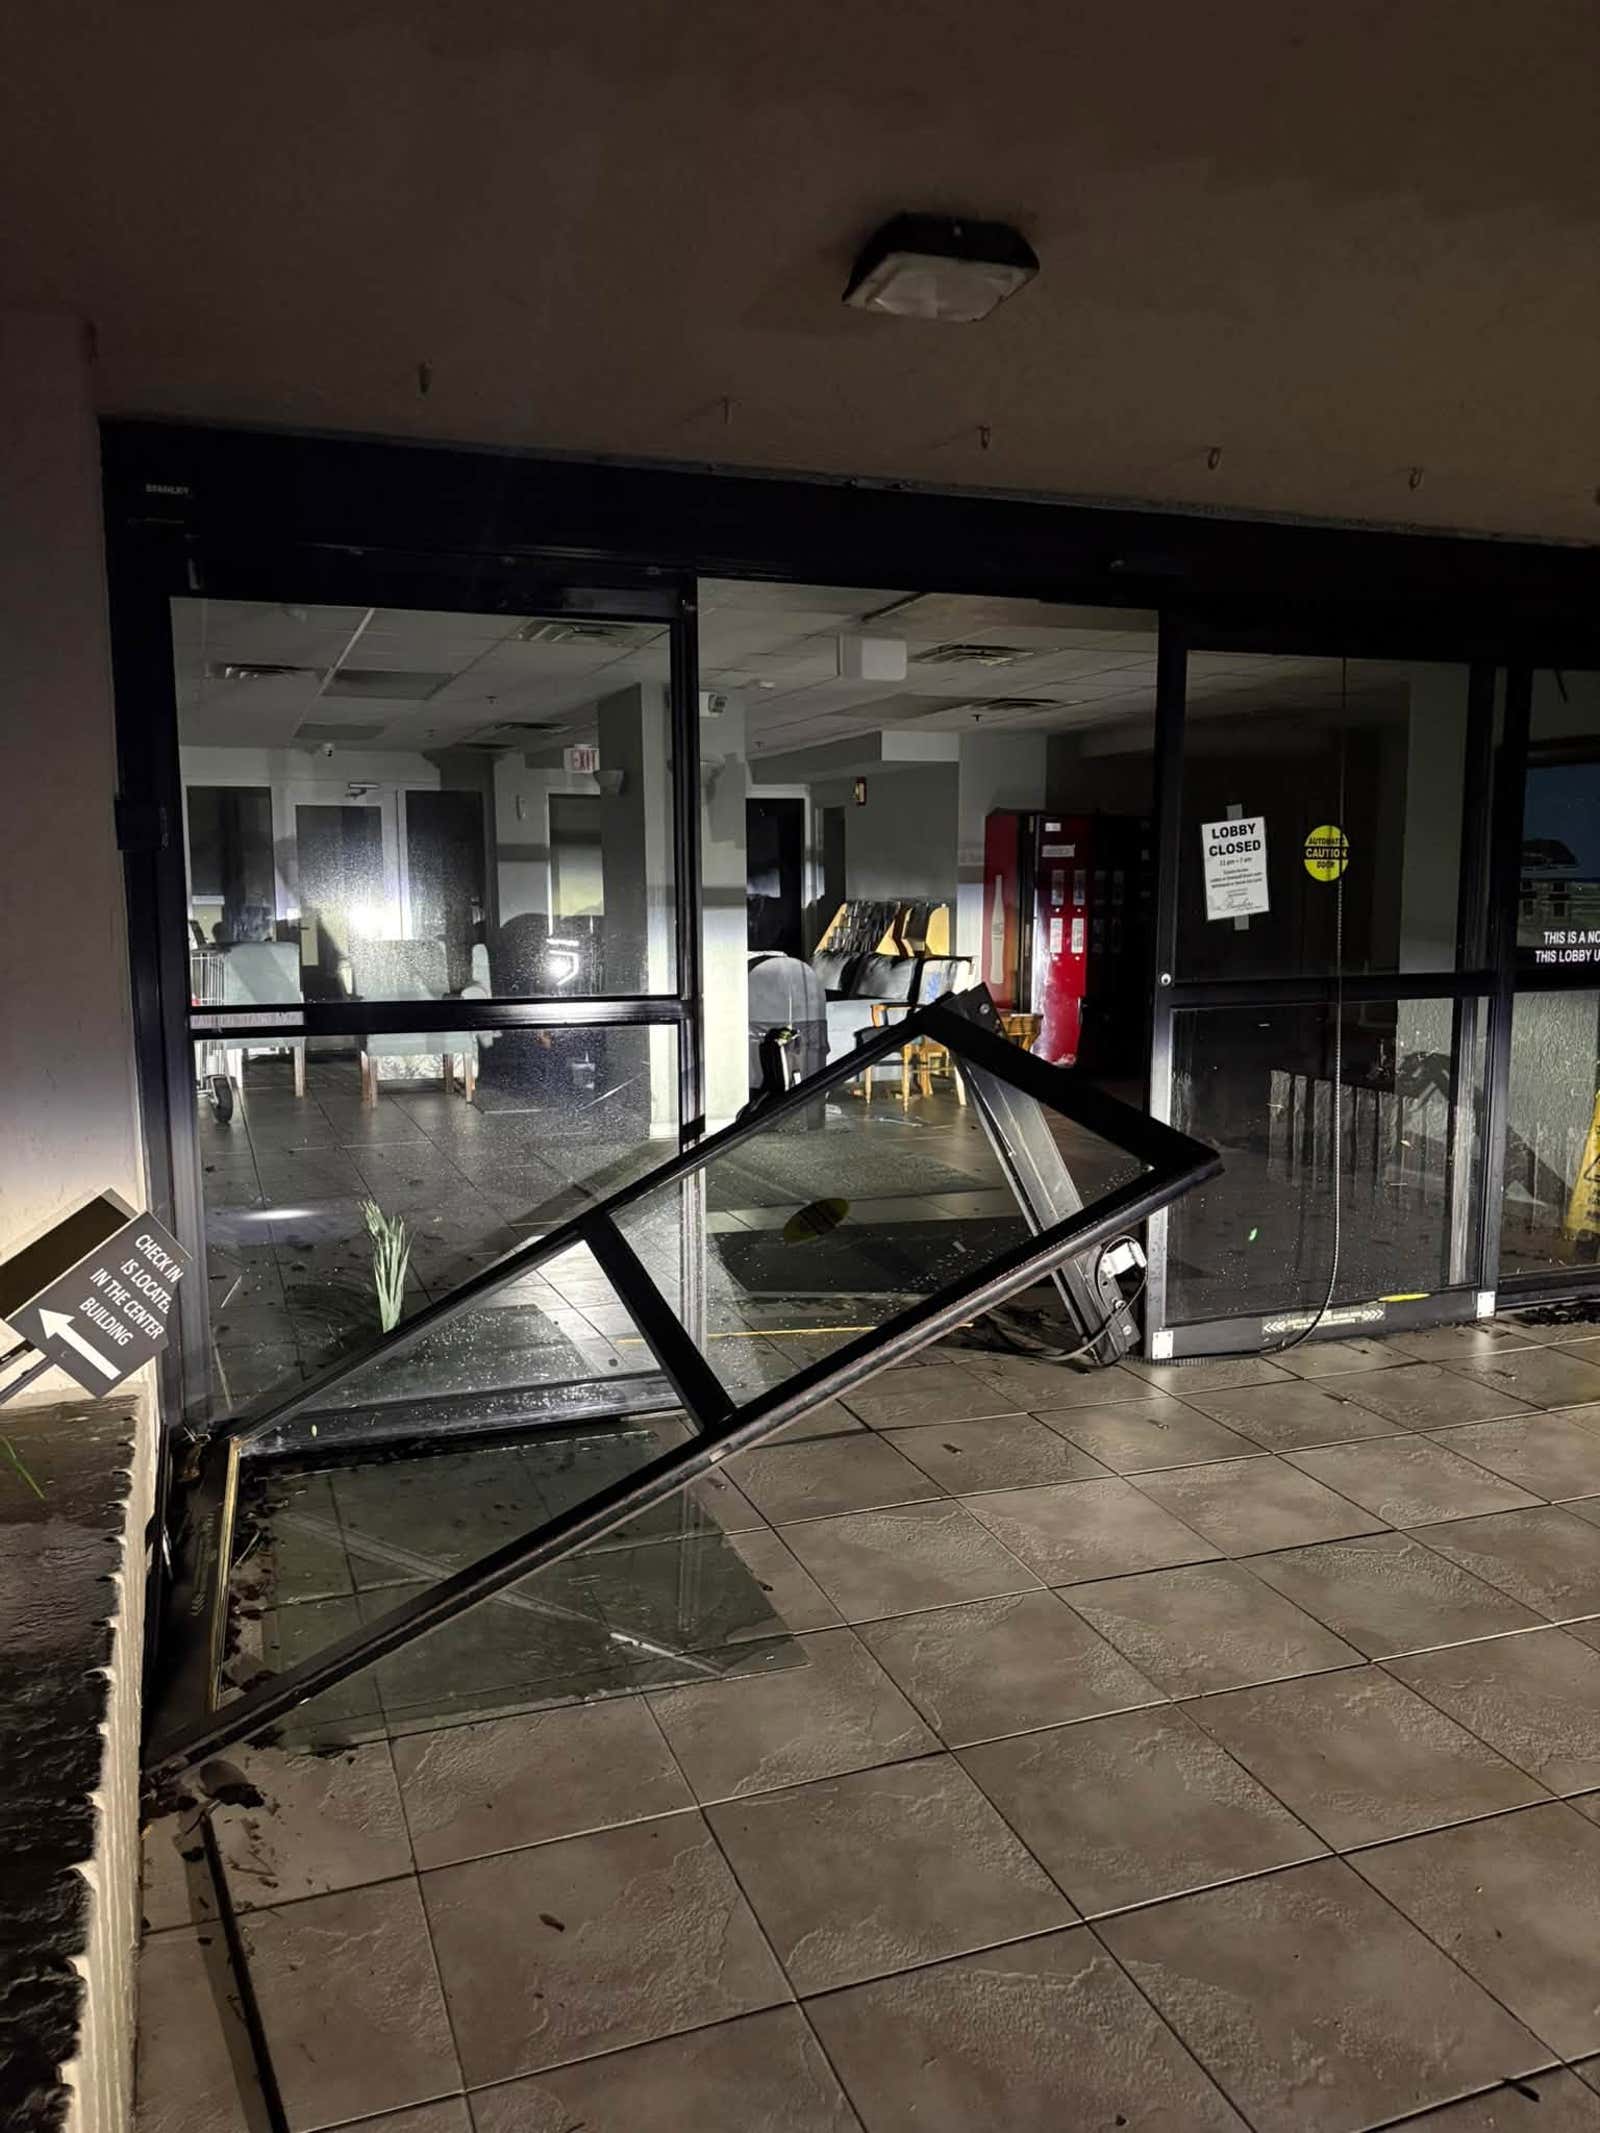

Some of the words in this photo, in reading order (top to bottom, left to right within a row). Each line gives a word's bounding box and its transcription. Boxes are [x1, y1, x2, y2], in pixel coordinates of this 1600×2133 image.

[571, 750, 597, 770] EXIT
[1211, 823, 1256, 839] LOBBY
[1209, 840, 1261, 857] CLOSED
[1544, 931, 1565, 944] THIS
[1567, 931, 1577, 944] IS
[1578, 931, 1586, 943] A
[1535, 950, 1556, 963] THIS
[1558, 949, 1592, 963] LOBBY
[120, 1258, 139, 1276] IS
[135, 1234, 173, 1272] CHECK
[165, 1265, 184, 1284] IN
[90, 1268, 112, 1287] IN
[104, 1279, 131, 1306] THE
[123, 1300, 165, 1340] CENTER
[79, 1296, 134, 1346] BUILDING
